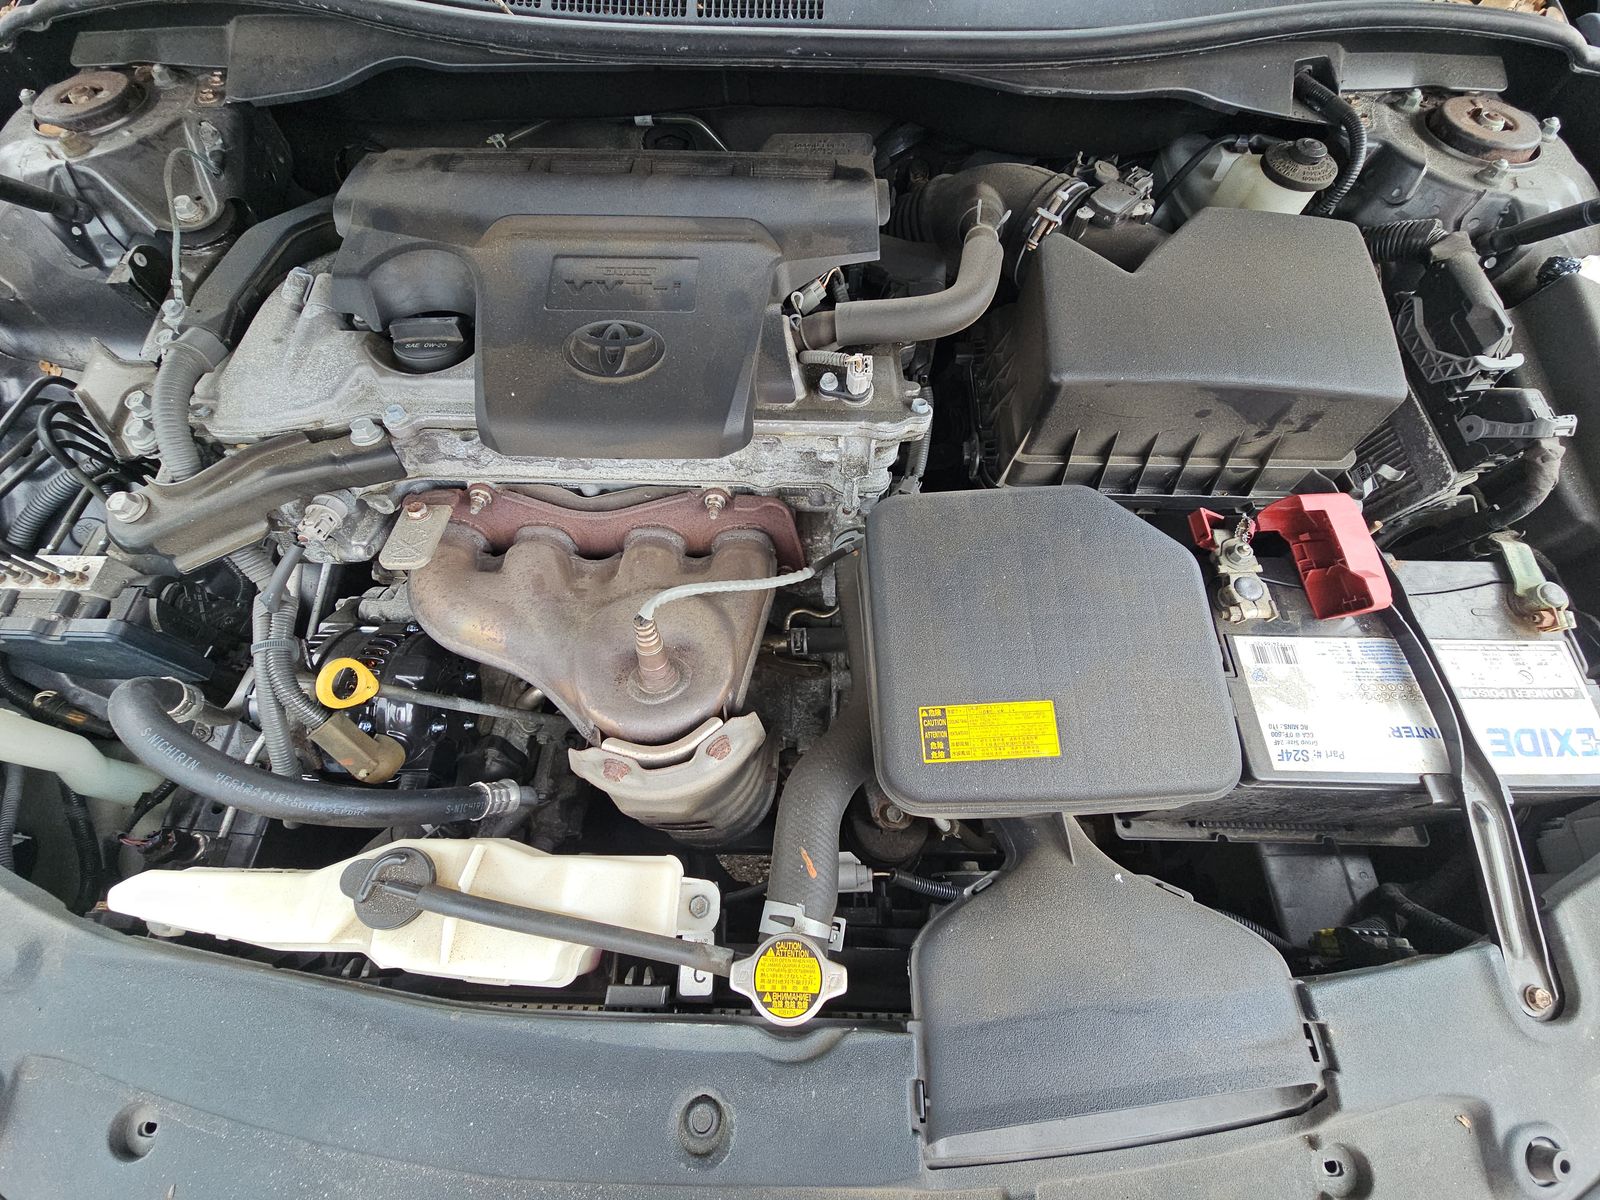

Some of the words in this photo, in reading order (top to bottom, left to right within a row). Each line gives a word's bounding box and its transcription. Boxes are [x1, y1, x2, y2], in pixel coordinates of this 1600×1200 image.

[1460, 687, 1507, 698] POISON
[1515, 688, 1563, 699] DANGER
[923, 718, 947, 727] CAUTION
[925, 730, 948, 739] ATTENTION
[1388, 726, 1440, 739] INTER
[1486, 728, 1600, 757] EXIDE
[140, 727, 201, 771] S-NICHIRIN
[1277, 749, 1310, 762] S24F
[1325, 750, 1345, 760] Part
